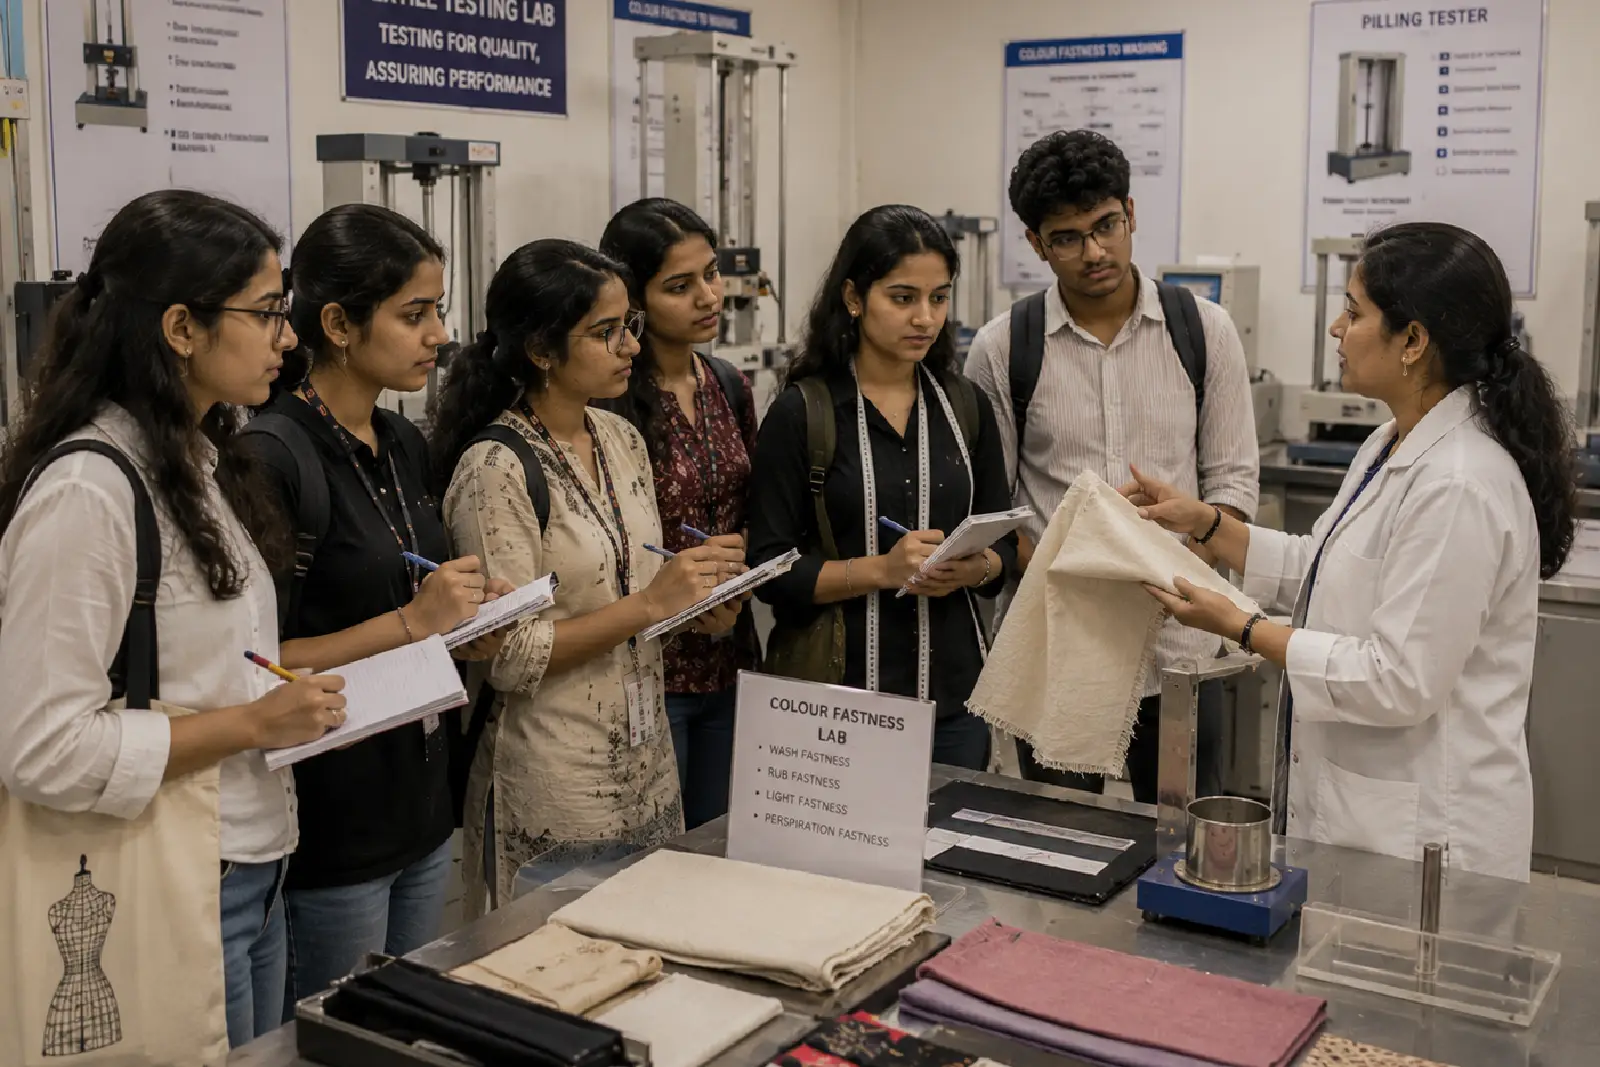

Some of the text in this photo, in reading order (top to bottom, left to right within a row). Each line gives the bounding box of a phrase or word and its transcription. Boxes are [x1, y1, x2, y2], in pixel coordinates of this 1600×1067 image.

[523, 1, 555, 27] LAB
[1362, 8, 1488, 29] PILLING TESTER
[378, 22, 540, 64] TESTING FOR QUALITY,
[365, 60, 552, 98] ASSURING PERFORMANCE
[770, 697, 905, 731] COLOUR FASTNESS
[818, 727, 847, 745] LAB
[769, 744, 850, 767] WASH FASTNESS
[768, 766, 840, 790] RUB FASTNESS
[766, 790, 848, 815] LIGHT FASTNESS
[765, 813, 889, 847] PERSPIRATION FASTNESS
